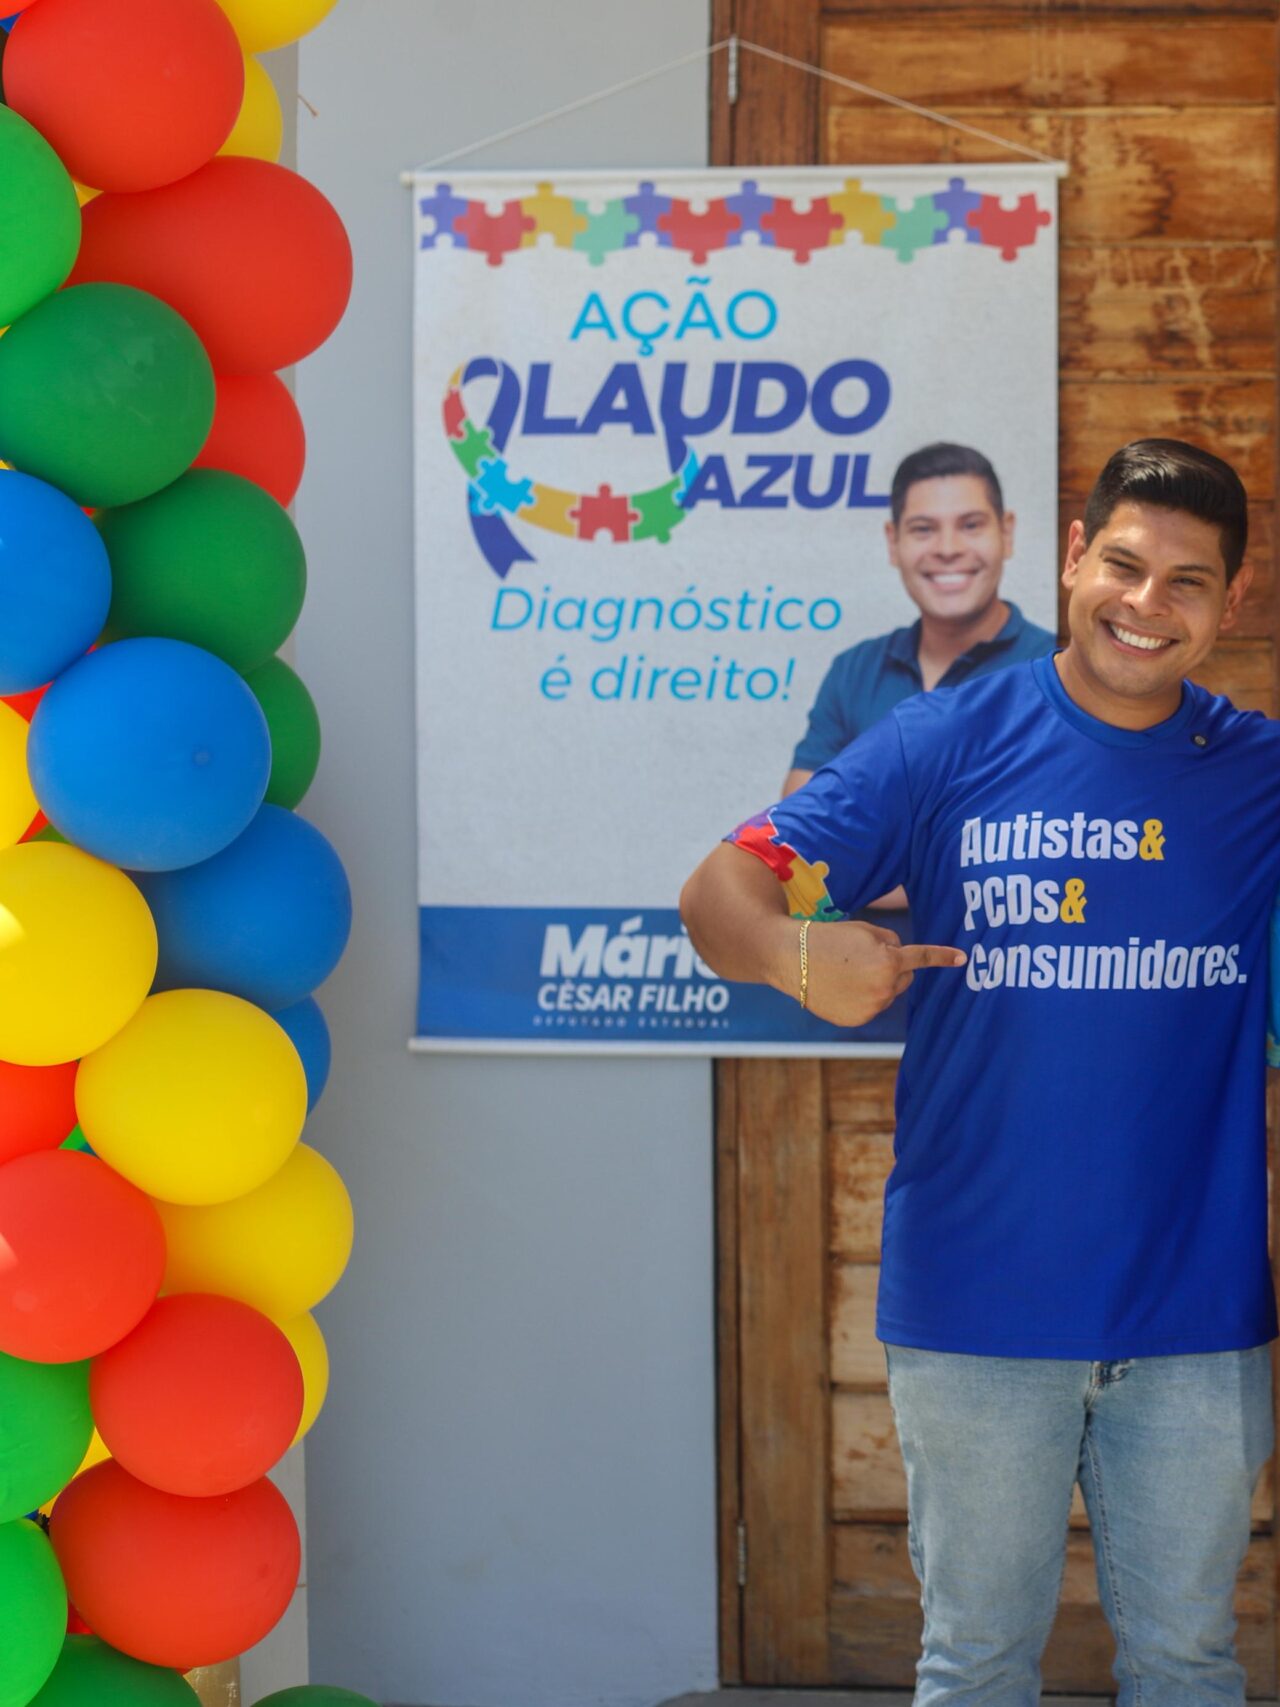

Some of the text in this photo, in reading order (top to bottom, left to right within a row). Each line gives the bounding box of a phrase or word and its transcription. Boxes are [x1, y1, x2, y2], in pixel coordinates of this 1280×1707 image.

[569, 275, 778, 357] AÇÃO
[520, 358, 891, 436] LAUDO
[678, 454, 893, 510] AZUL
[490, 585, 842, 642] Diagnóstico
[539, 652, 796, 701] é direito!
[539, 915, 721, 980] Mári
[965, 937, 1248, 992] Consumidores.
[537, 978, 730, 1013] CÉSAR FILHO
